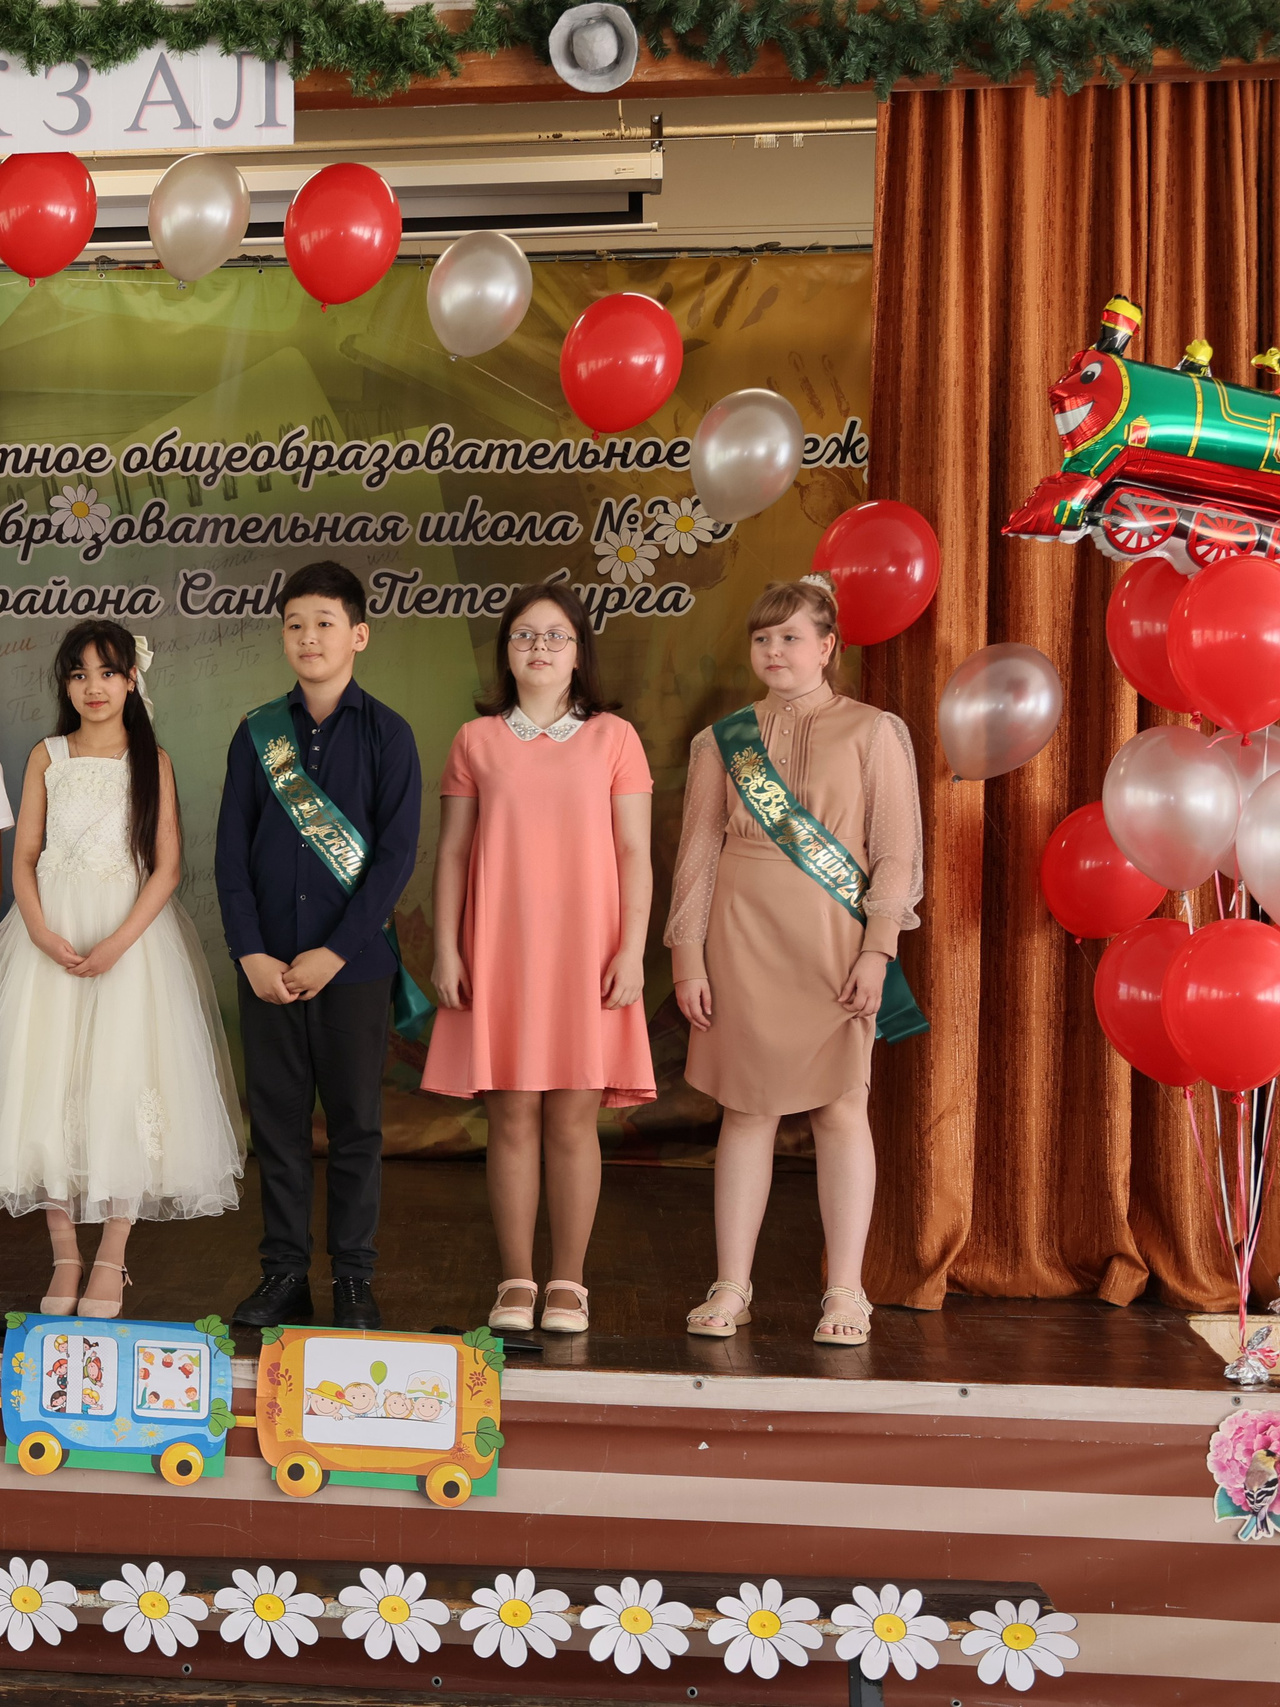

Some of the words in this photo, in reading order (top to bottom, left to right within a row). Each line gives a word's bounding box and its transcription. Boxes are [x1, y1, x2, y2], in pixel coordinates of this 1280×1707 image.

[123, 428, 691, 488] общеобразовательное
[420, 498, 582, 542] школа
[276, 772, 364, 881] Выпускни
[748, 779, 850, 885] Выпускник
